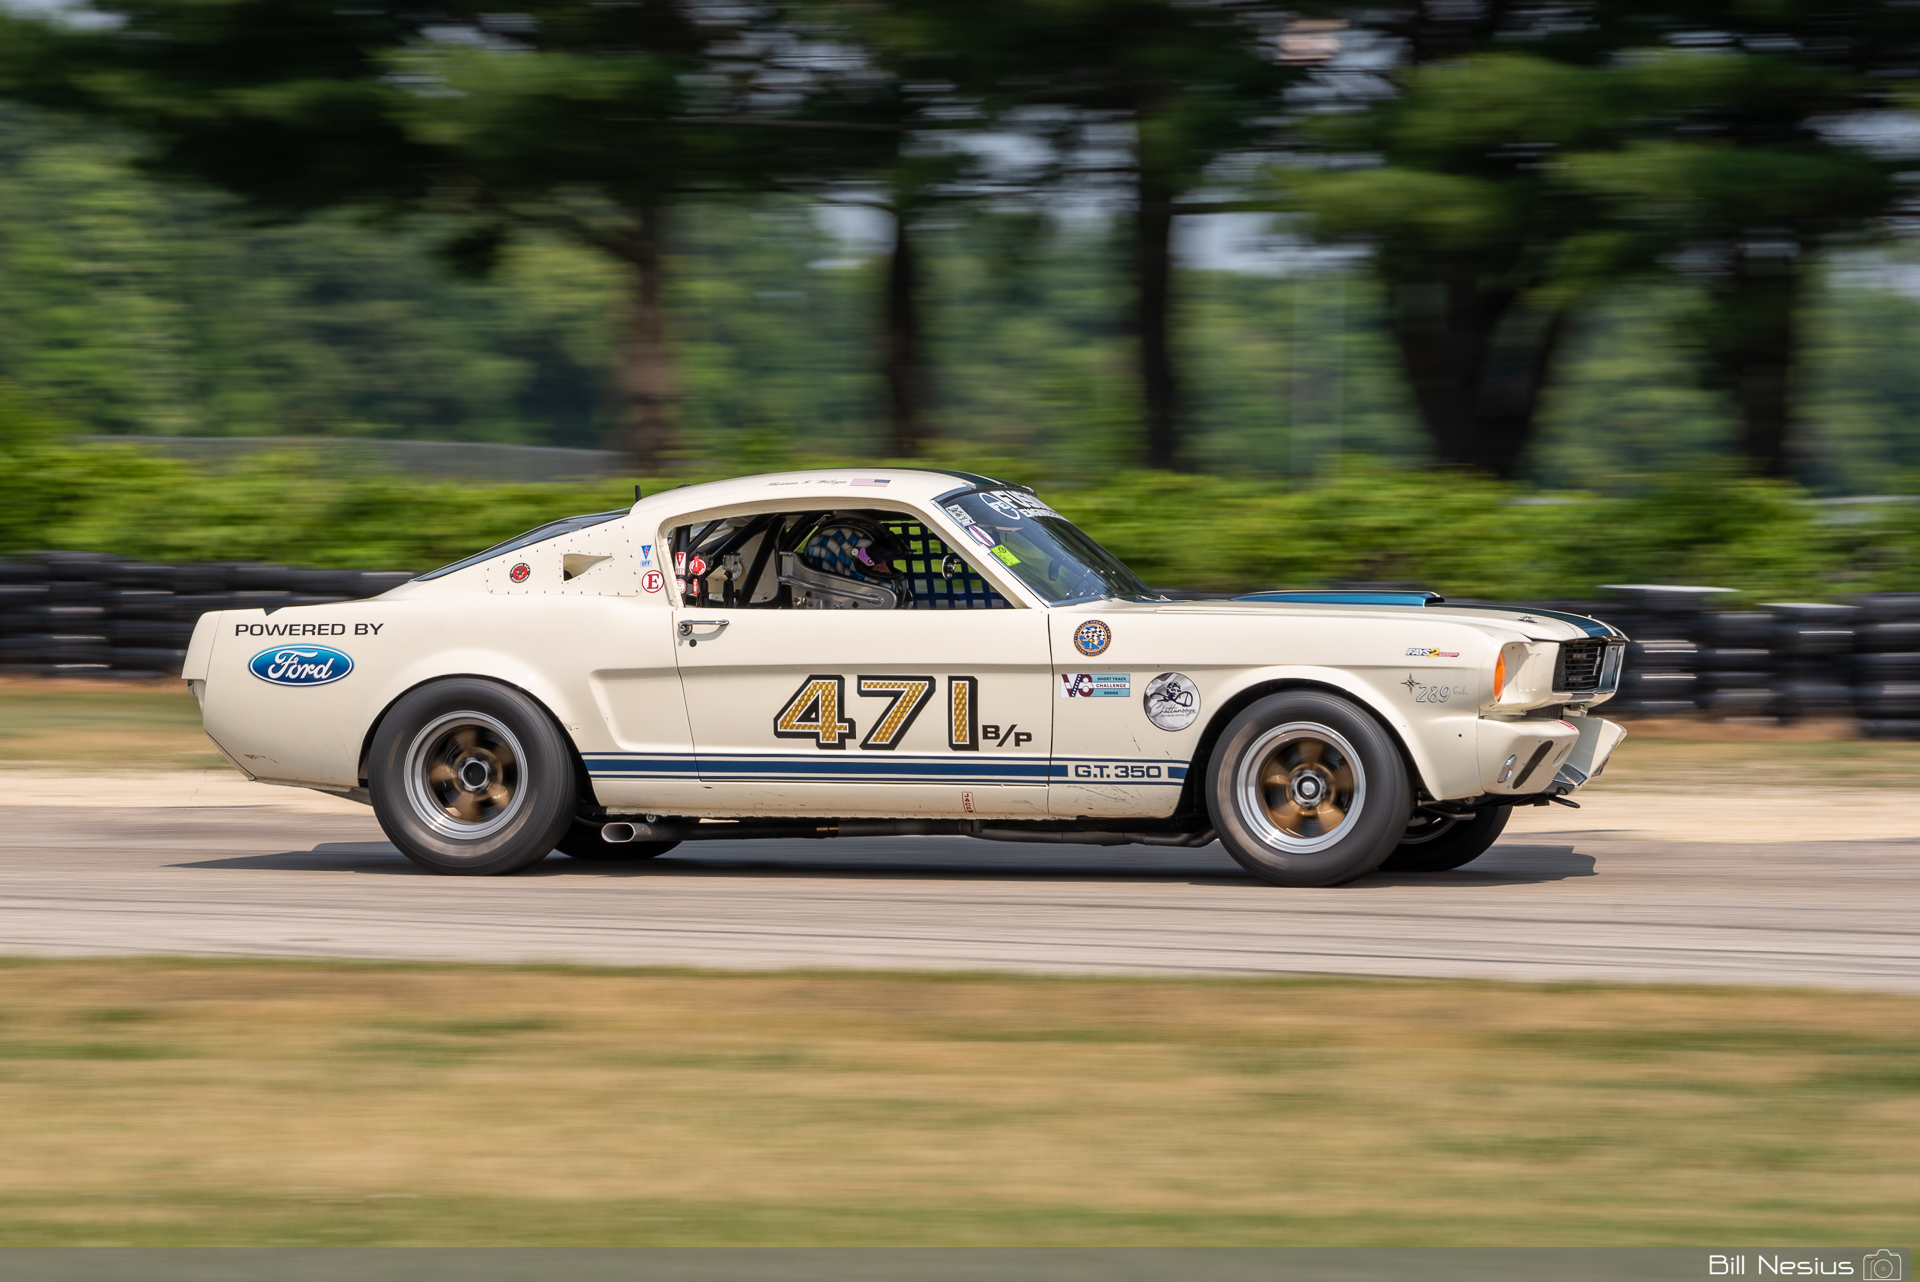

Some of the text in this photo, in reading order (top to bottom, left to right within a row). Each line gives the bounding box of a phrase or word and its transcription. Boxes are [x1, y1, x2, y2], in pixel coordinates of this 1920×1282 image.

[647, 573, 659, 589] E
[235, 623, 384, 636] POWERED BY
[267, 650, 334, 679] Ford
[1416, 686, 1450, 703] 289
[773, 674, 1032, 751] 471 B/P
